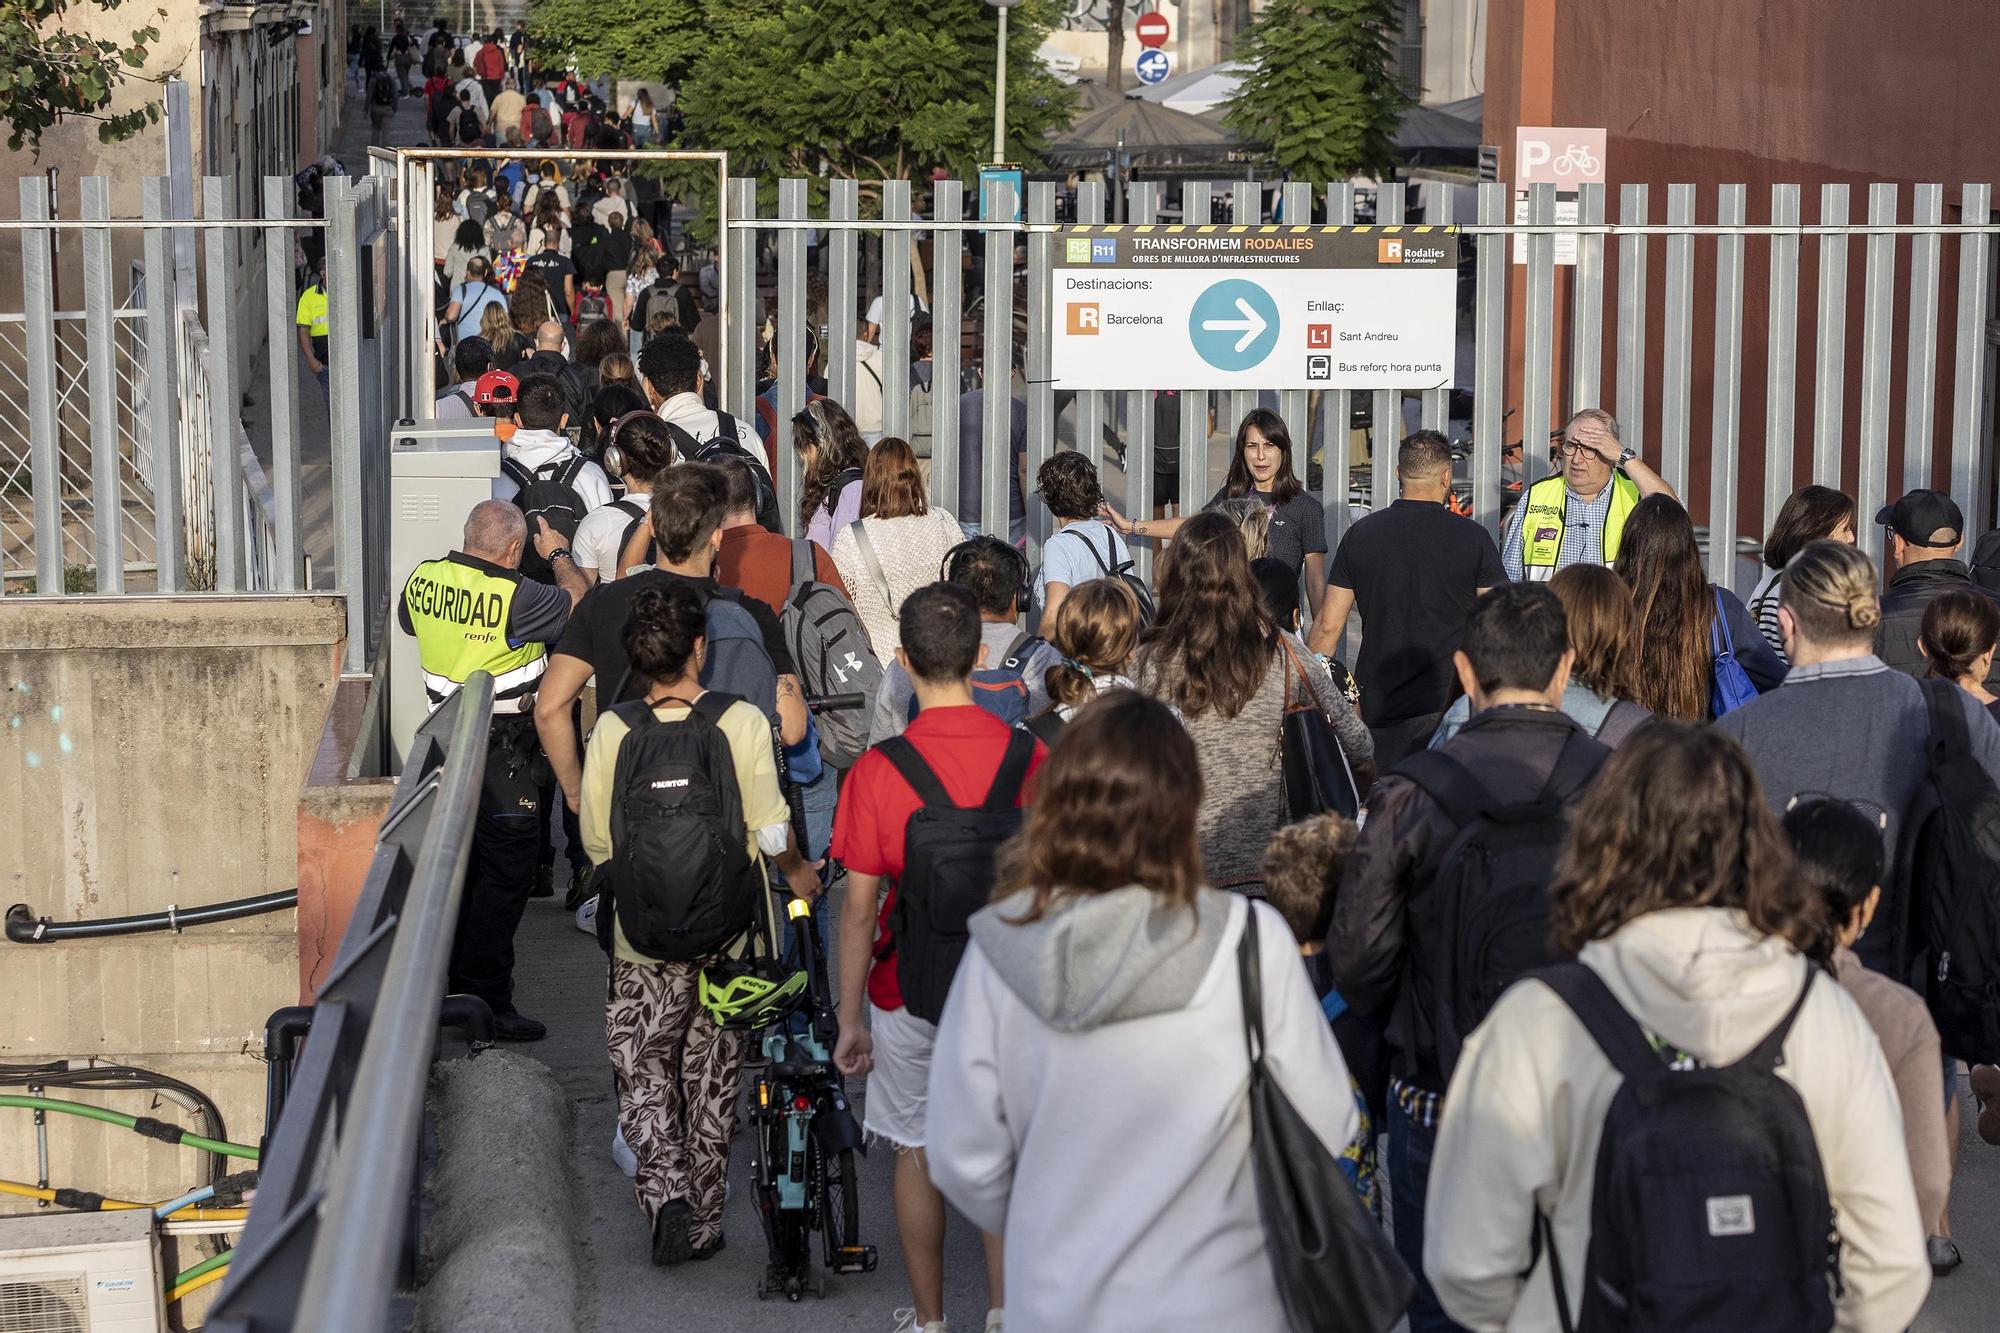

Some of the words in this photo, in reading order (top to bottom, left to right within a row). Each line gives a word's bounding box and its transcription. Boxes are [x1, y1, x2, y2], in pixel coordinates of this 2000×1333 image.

[1522, 141, 1551, 178] P
[1070, 241, 1088, 253] R2
[1132, 238, 1241, 250] TRANSFORMEM
[1244, 238, 1314, 250] RODALIES
[1387, 242, 1402, 258] R
[1093, 245, 1115, 256] R11
[1404, 248, 1445, 258] Rodalies
[1132, 255, 1159, 264] OBRES
[1161, 255, 1173, 264] DE
[1175, 255, 1210, 264] MILLORA
[1066, 278, 1153, 290] Destinacions:
[1307, 300, 1345, 314] Enllaç:
[1079, 307, 1099, 328] R
[1107, 313, 1164, 325] Barcelona
[1311, 329, 1328, 344] L1
[1339, 331, 1362, 342] Sant
[1364, 331, 1399, 342] Andreu
[1338, 362, 1358, 372] Bus
[1360, 362, 1388, 374] reforç
[1390, 362, 1412, 372] hora
[1414, 363, 1442, 374] punta
[408, 576, 503, 628] SEGURIDAD
[464, 632, 497, 643] renfe
